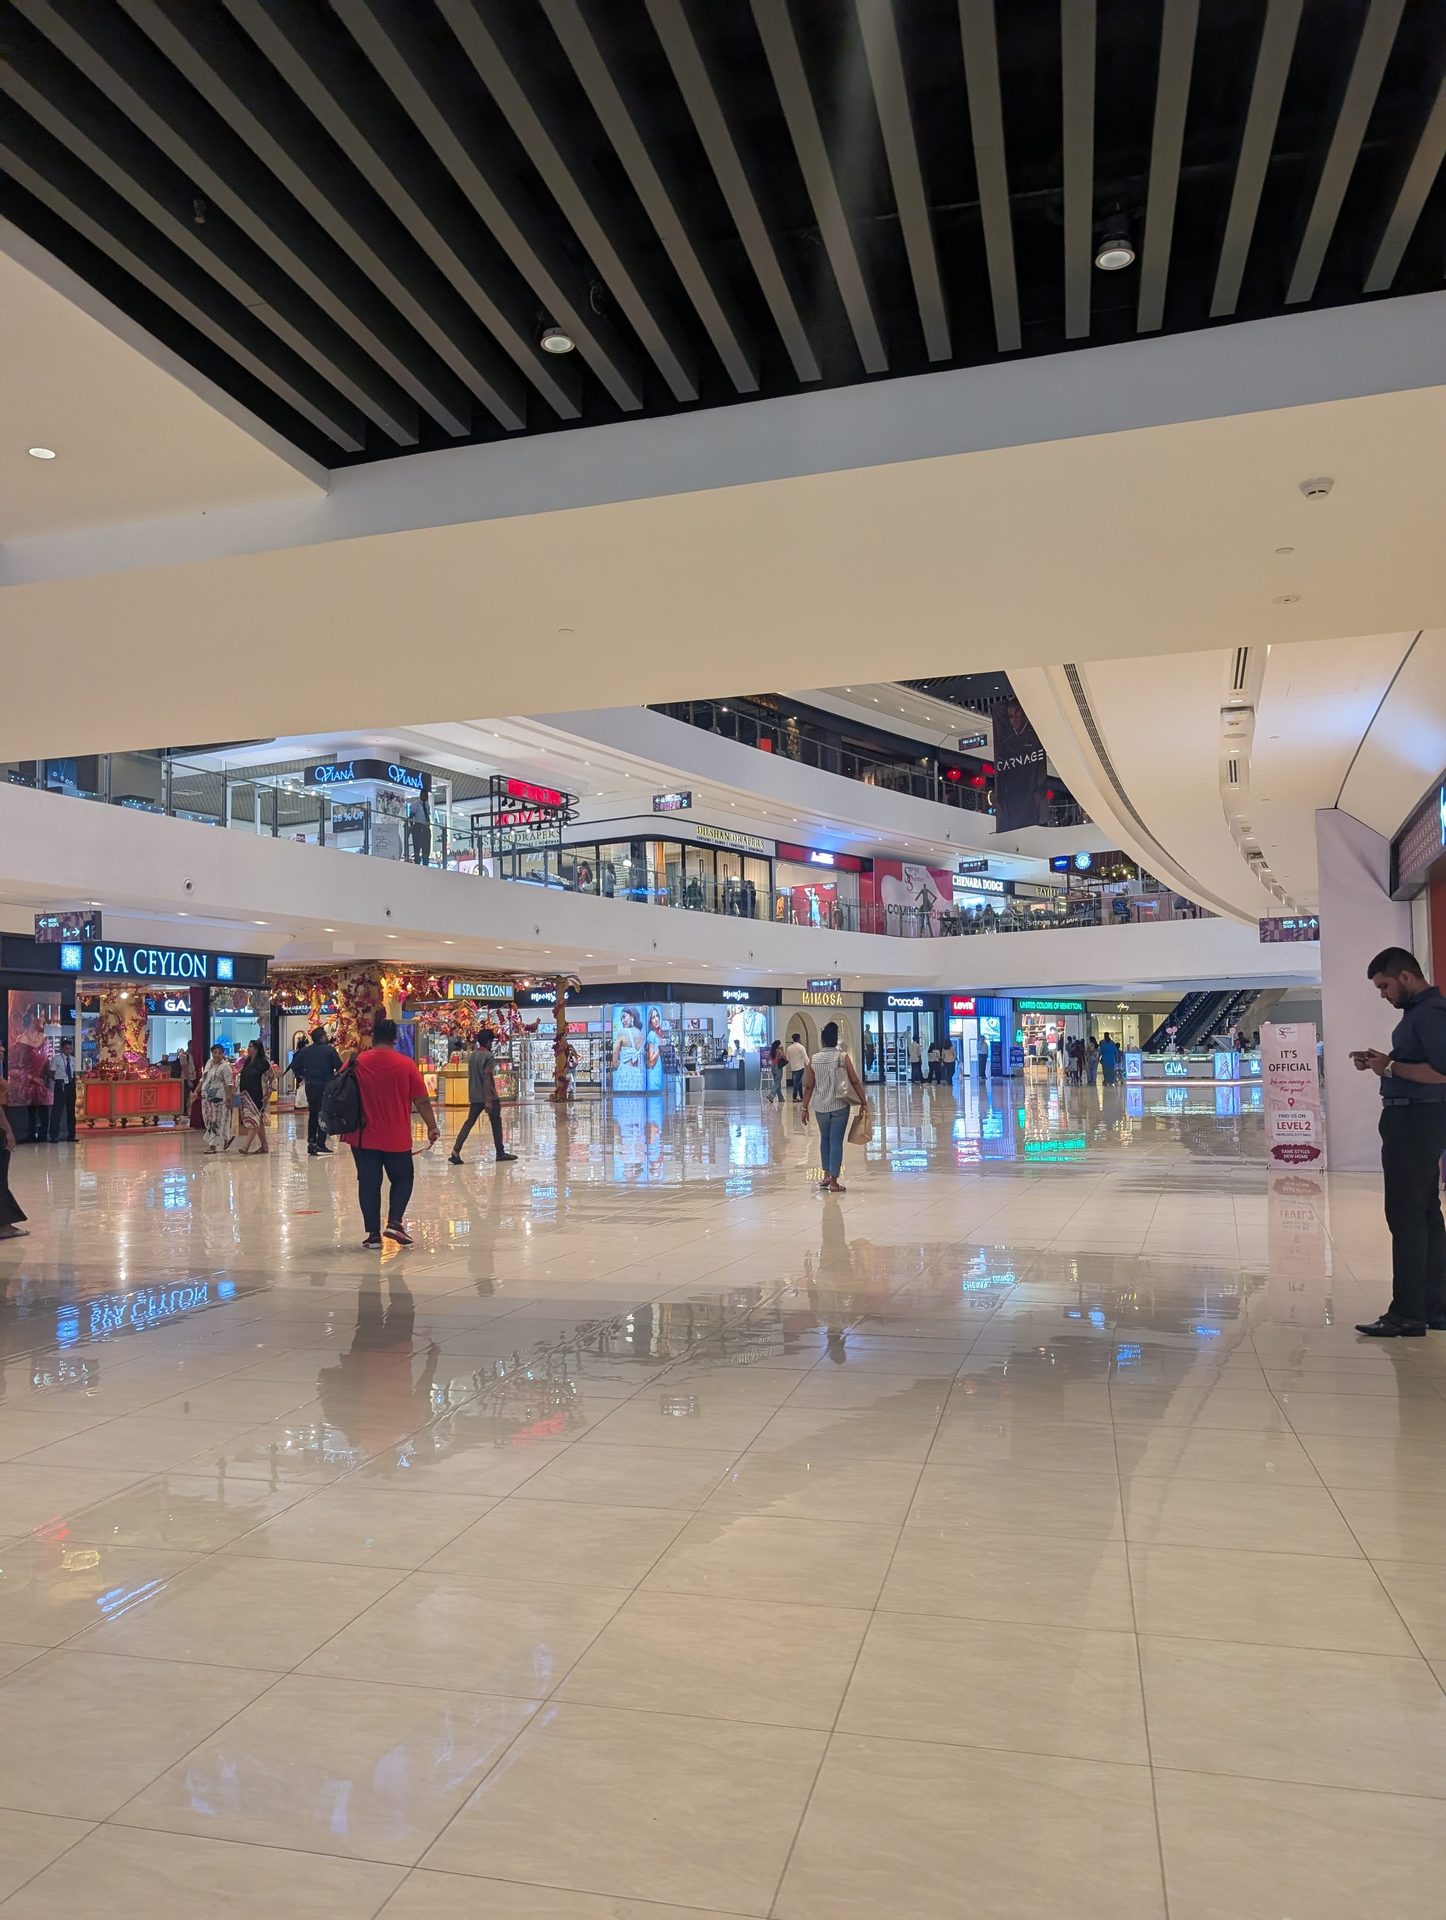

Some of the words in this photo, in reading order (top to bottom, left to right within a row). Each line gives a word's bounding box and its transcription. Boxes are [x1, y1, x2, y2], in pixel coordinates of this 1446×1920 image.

[997, 749, 1044, 771] CARNAGE
[952, 874, 983, 889] CHENARA
[982, 879, 1004, 892] DODGE
[84, 924, 90, 938] 1
[93, 946, 129, 974] SPA
[133, 948, 208, 979] CEYLON
[461, 983, 475, 997] SPA
[476, 983, 506, 998] CEYLON
[802, 991, 843, 1006] MIMOSA
[887, 995, 924, 1007] Crocodile
[1019, 1001, 1036, 1009] UNITED
[1036, 1001, 1053, 1010] COLORS
[1053, 1002, 1060, 1010] OF
[1280, 1050, 1298, 1059] IT'S
[1268, 1062, 1312, 1072] OFFICIAL
[1276, 1121, 1304, 1130] LEVEL
[1304, 1121, 1312, 1131] 2
